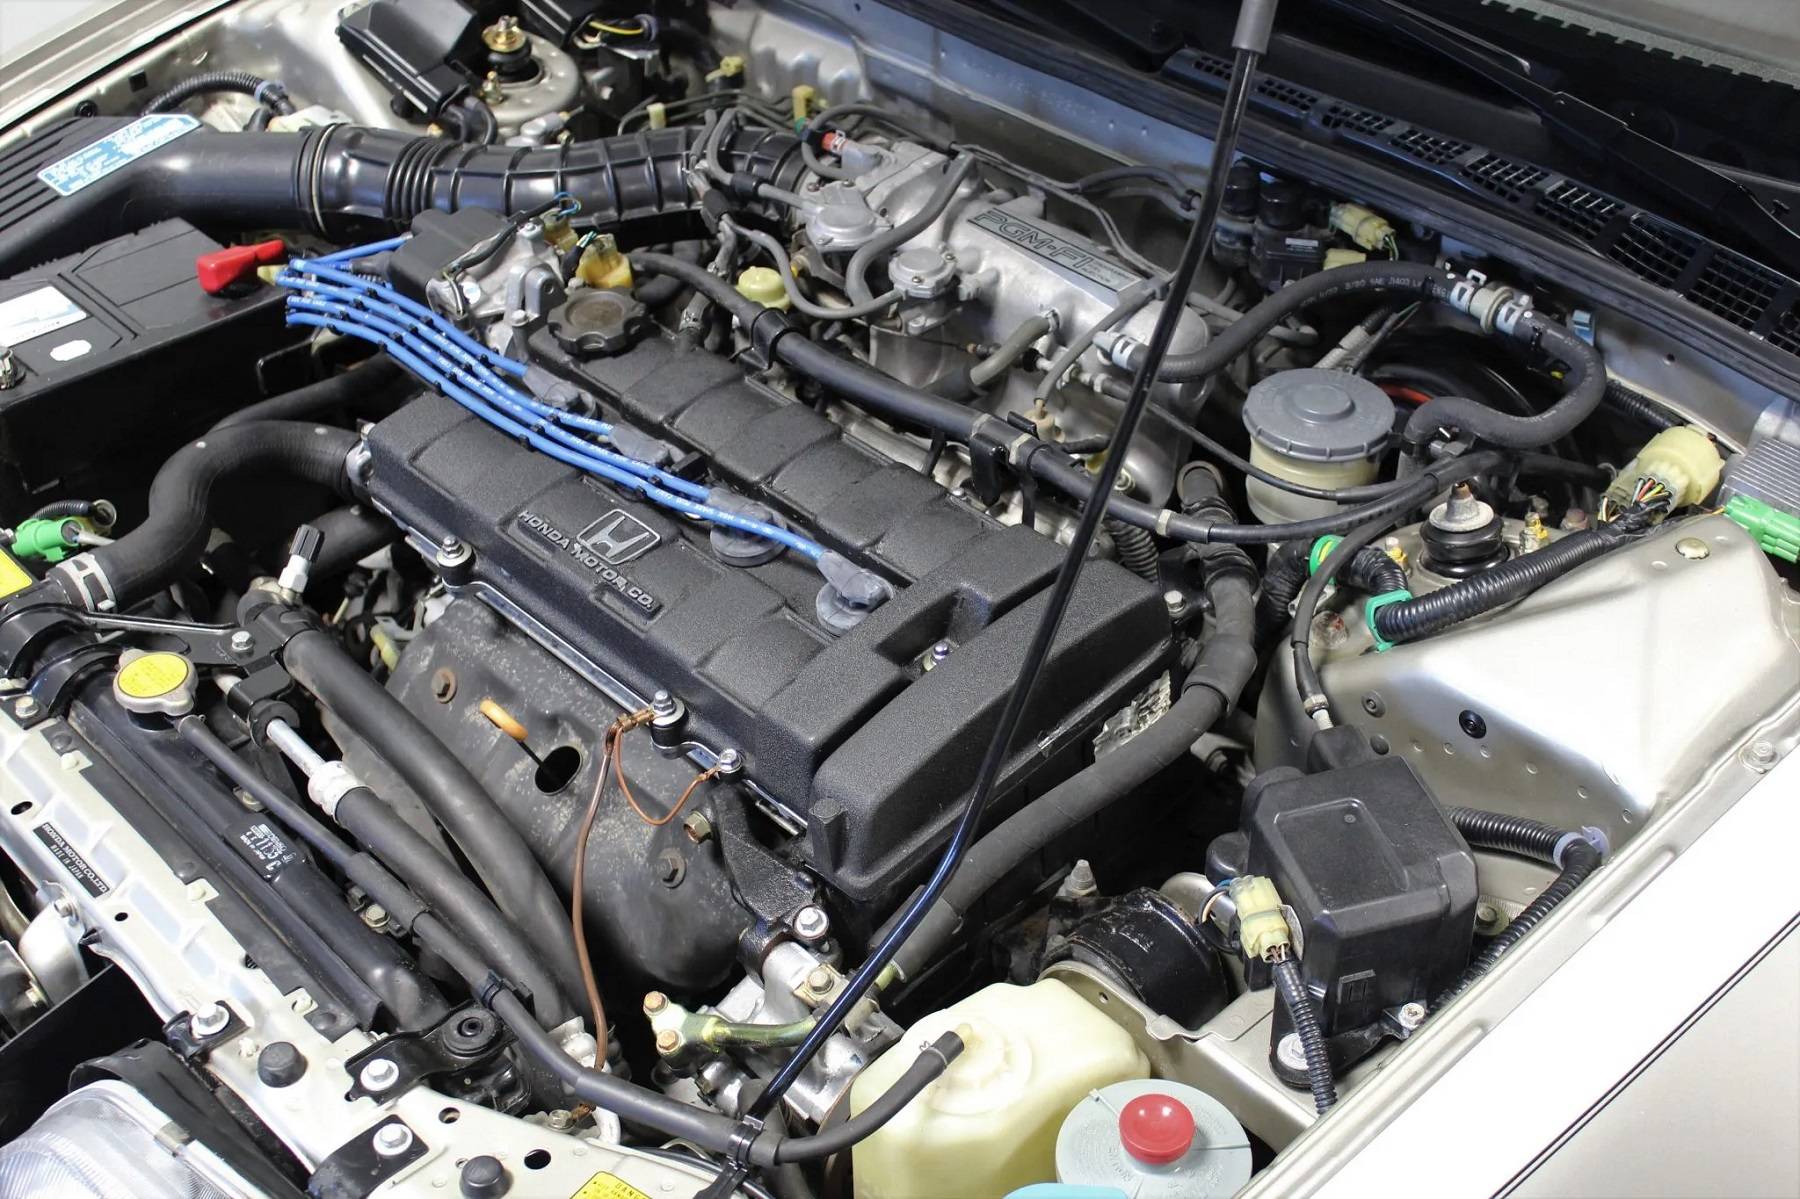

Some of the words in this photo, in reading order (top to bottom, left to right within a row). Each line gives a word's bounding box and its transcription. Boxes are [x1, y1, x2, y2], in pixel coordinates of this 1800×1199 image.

[974, 209, 1095, 269] PGM-FI
[518, 510, 571, 549] HONDA
[570, 542, 628, 593] MOTOR
[627, 586, 655, 608] CO.
[41, 823, 66, 848] HONDA
[62, 845, 87, 871] MOTOR
